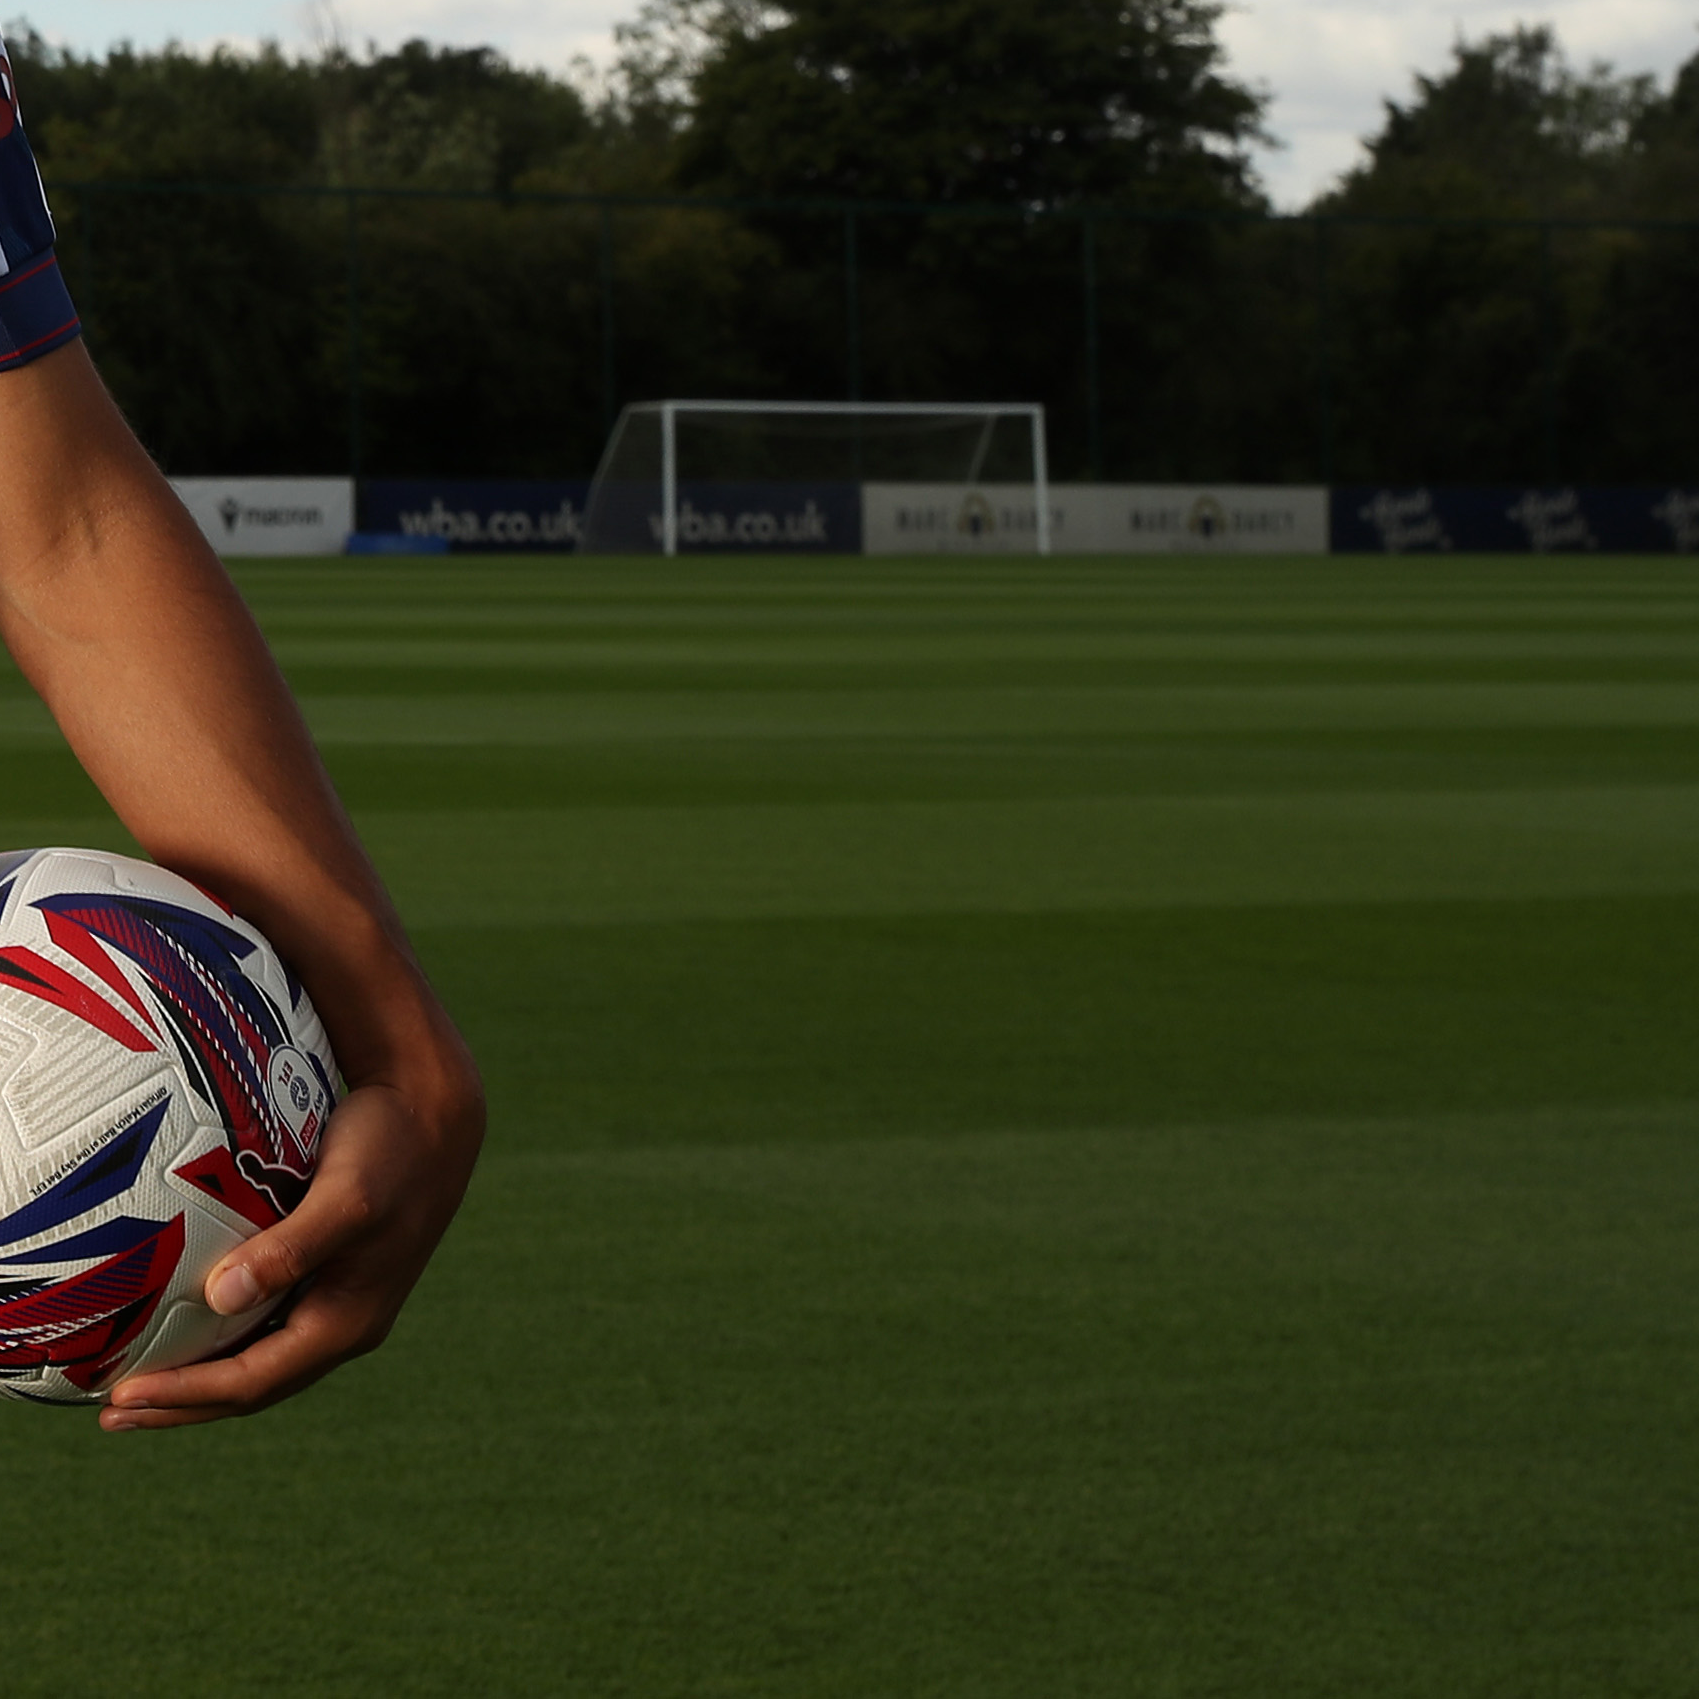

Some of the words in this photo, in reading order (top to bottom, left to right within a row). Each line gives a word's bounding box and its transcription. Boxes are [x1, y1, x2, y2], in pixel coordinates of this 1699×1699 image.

[278, 1060, 293, 1087] EFL
[138, 1086, 169, 1111] Official
[115, 1106, 142, 1130] Match
[97, 1126, 118, 1144] Ball
[75, 1147, 92, 1162] the
[59, 1158, 78, 1174] Sky
[45, 1171, 63, 1186] Bet
[29, 1181, 48, 1197] EFL
